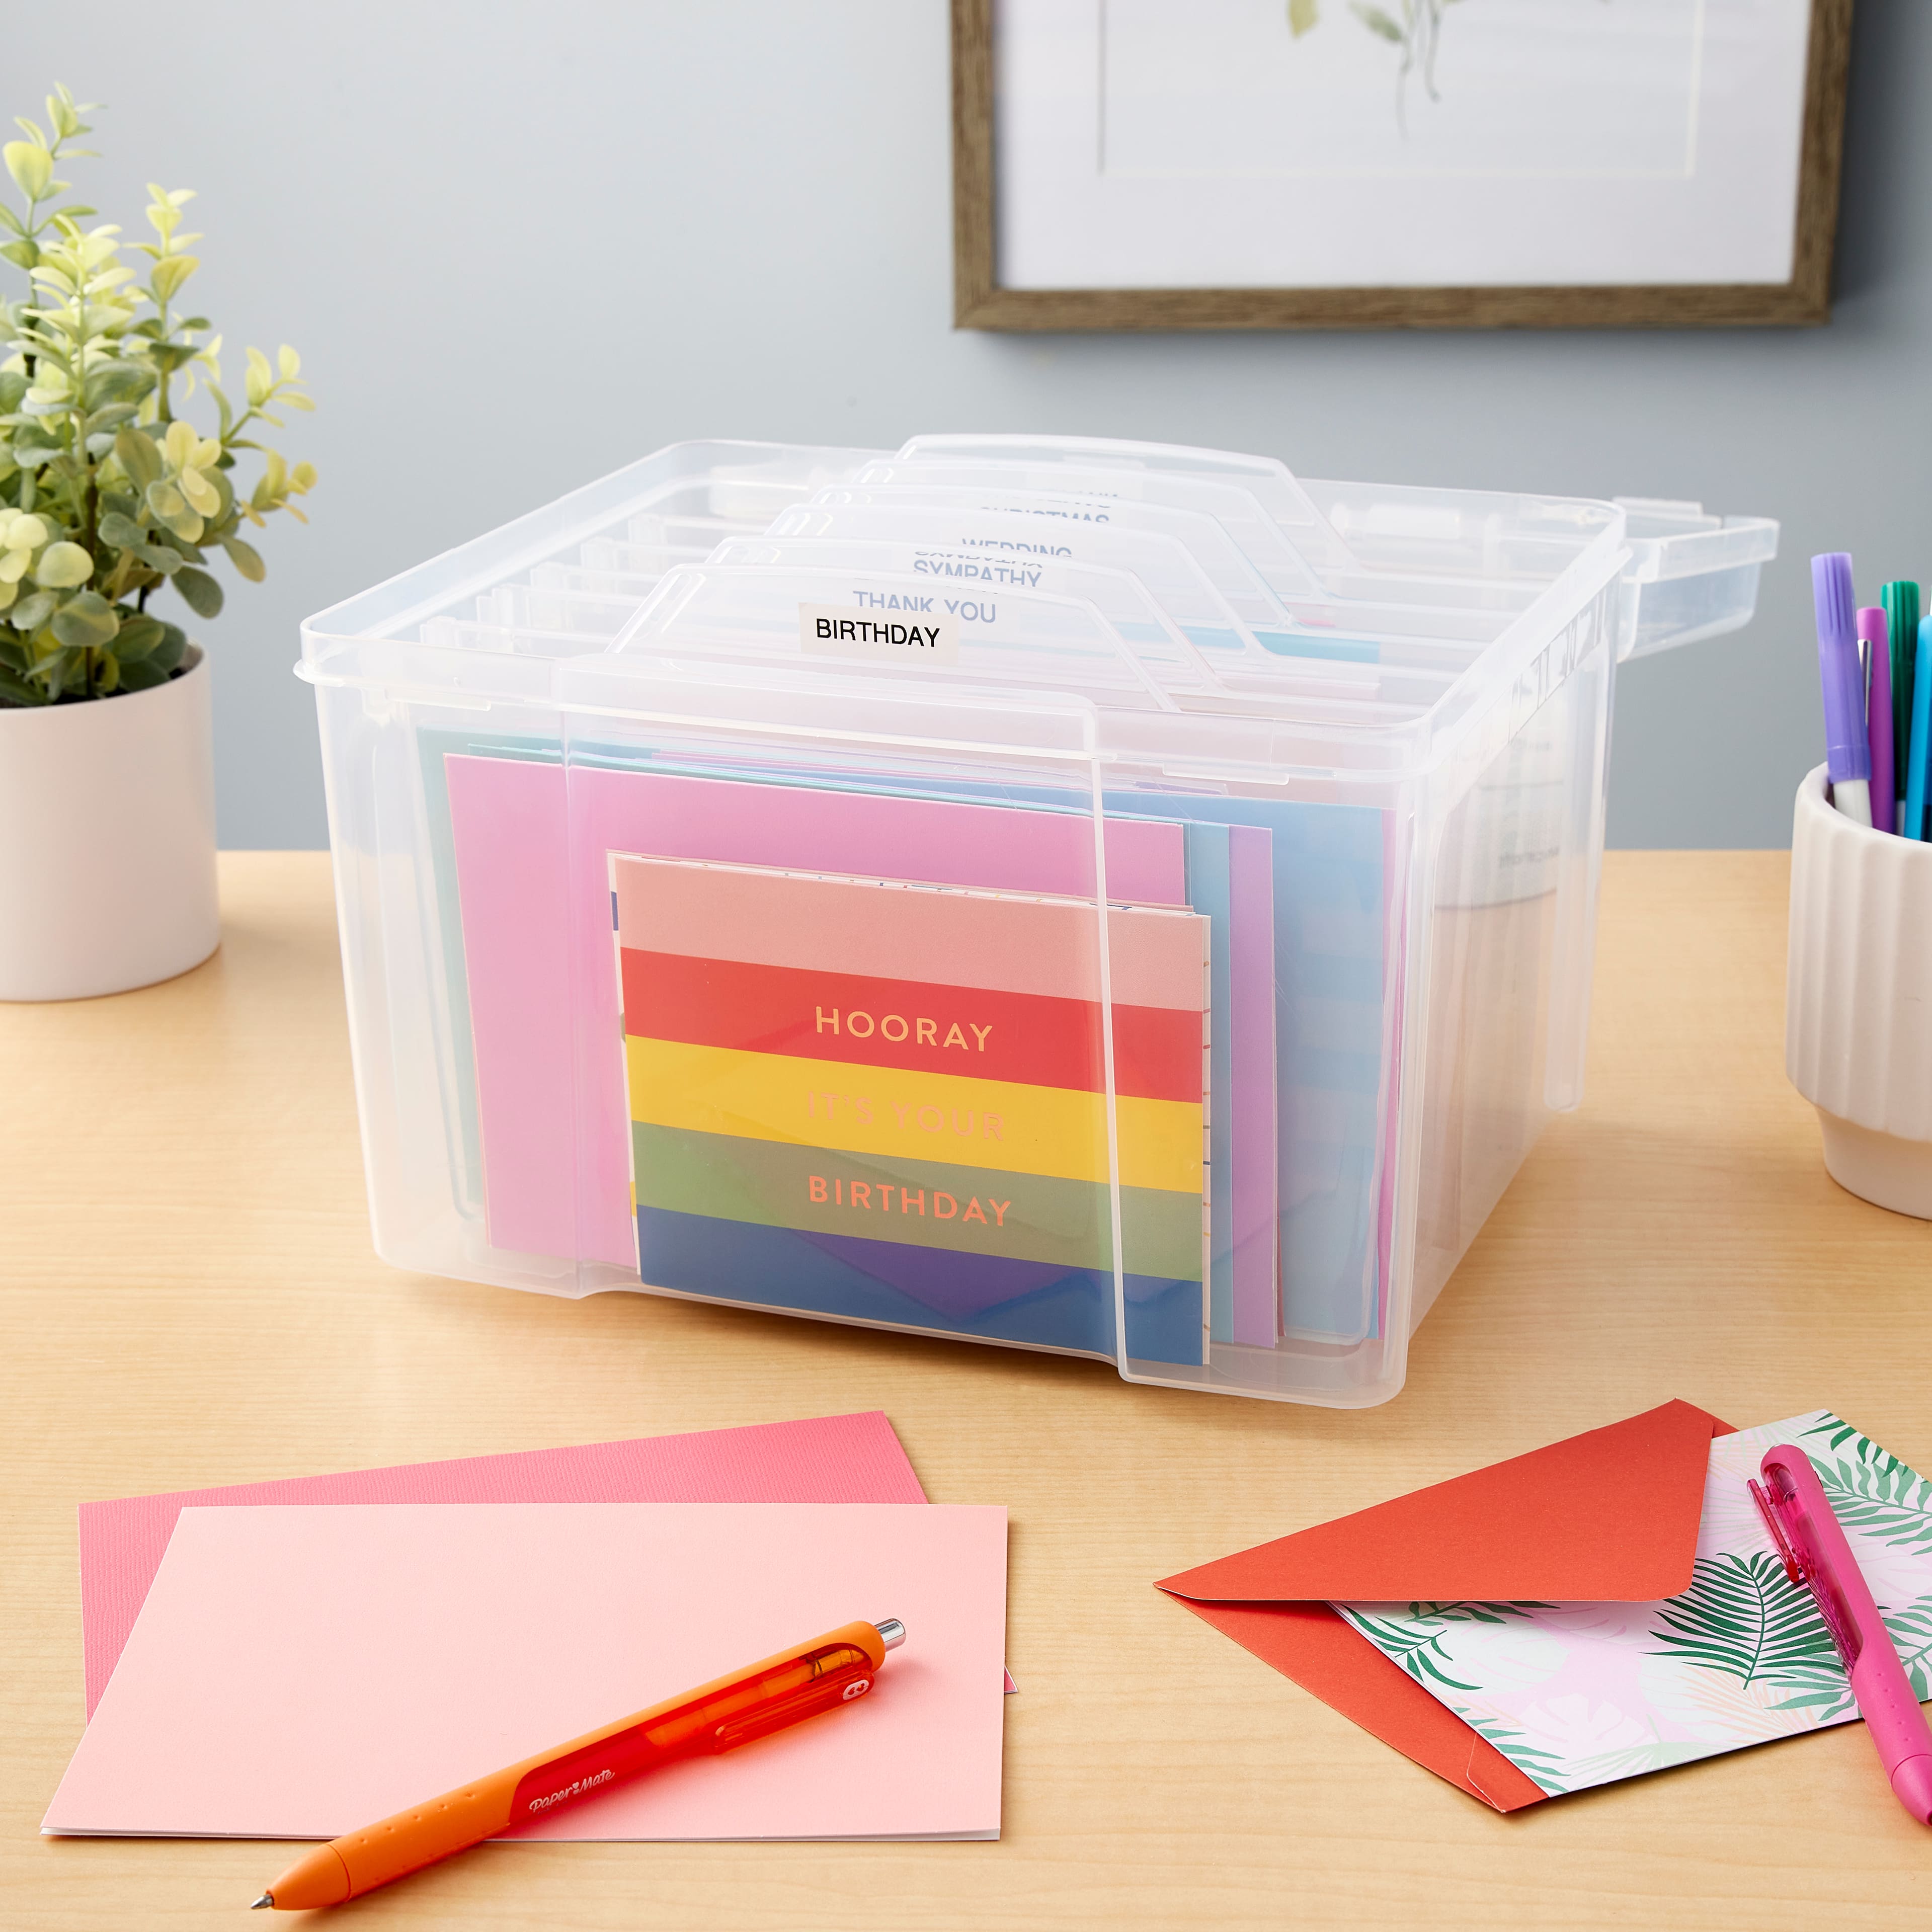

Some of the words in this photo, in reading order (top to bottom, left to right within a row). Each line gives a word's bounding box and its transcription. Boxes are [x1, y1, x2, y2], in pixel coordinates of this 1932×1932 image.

[914, 559, 1042, 587] SYMPATHY
[853, 591, 934, 612] THANK
[944, 599, 996, 623] YOU
[816, 618, 940, 648] BIRTHDAY
[816, 1006, 993, 1052] HOORAY
[808, 1091, 873, 1125] IT'S
[890, 1101, 1004, 1141] YOUR
[809, 1175, 1011, 1227] BIRTHDAY
